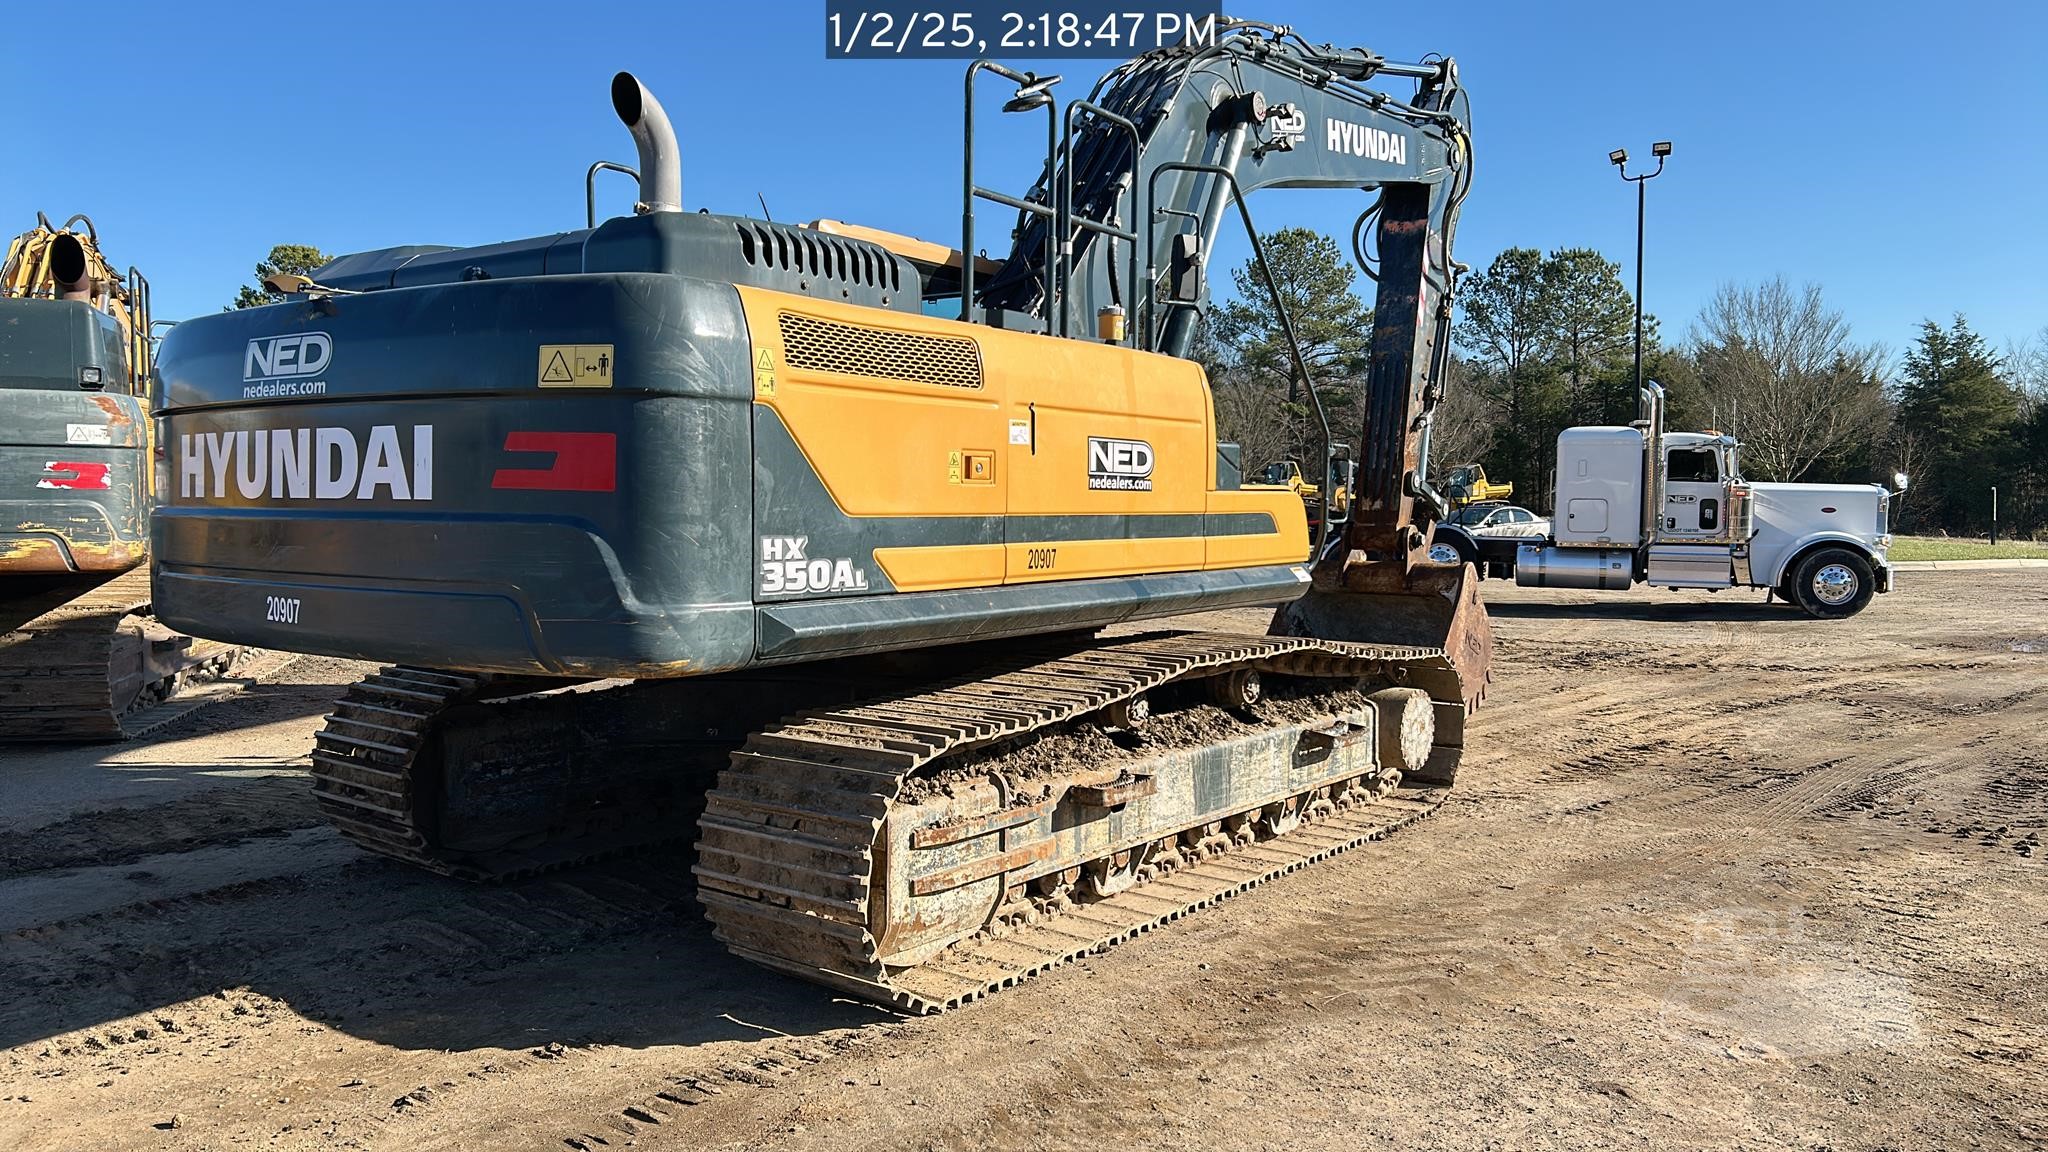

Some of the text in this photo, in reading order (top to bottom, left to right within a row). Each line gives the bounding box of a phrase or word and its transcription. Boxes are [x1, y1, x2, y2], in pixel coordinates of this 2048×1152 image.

[1327, 118, 1406, 165] HYUNDAI
[244, 333, 332, 380] NED
[243, 380, 326, 398] nedealers.com
[181, 425, 433, 500] HYUNDAI
[1089, 439, 1153, 475] NED
[1089, 476, 1152, 490] nedealers.com
[1667, 495, 1697, 504] NED
[762, 537, 807, 560] HX
[1028, 549, 1056, 569] 20907
[267, 596, 300, 624] 20907
